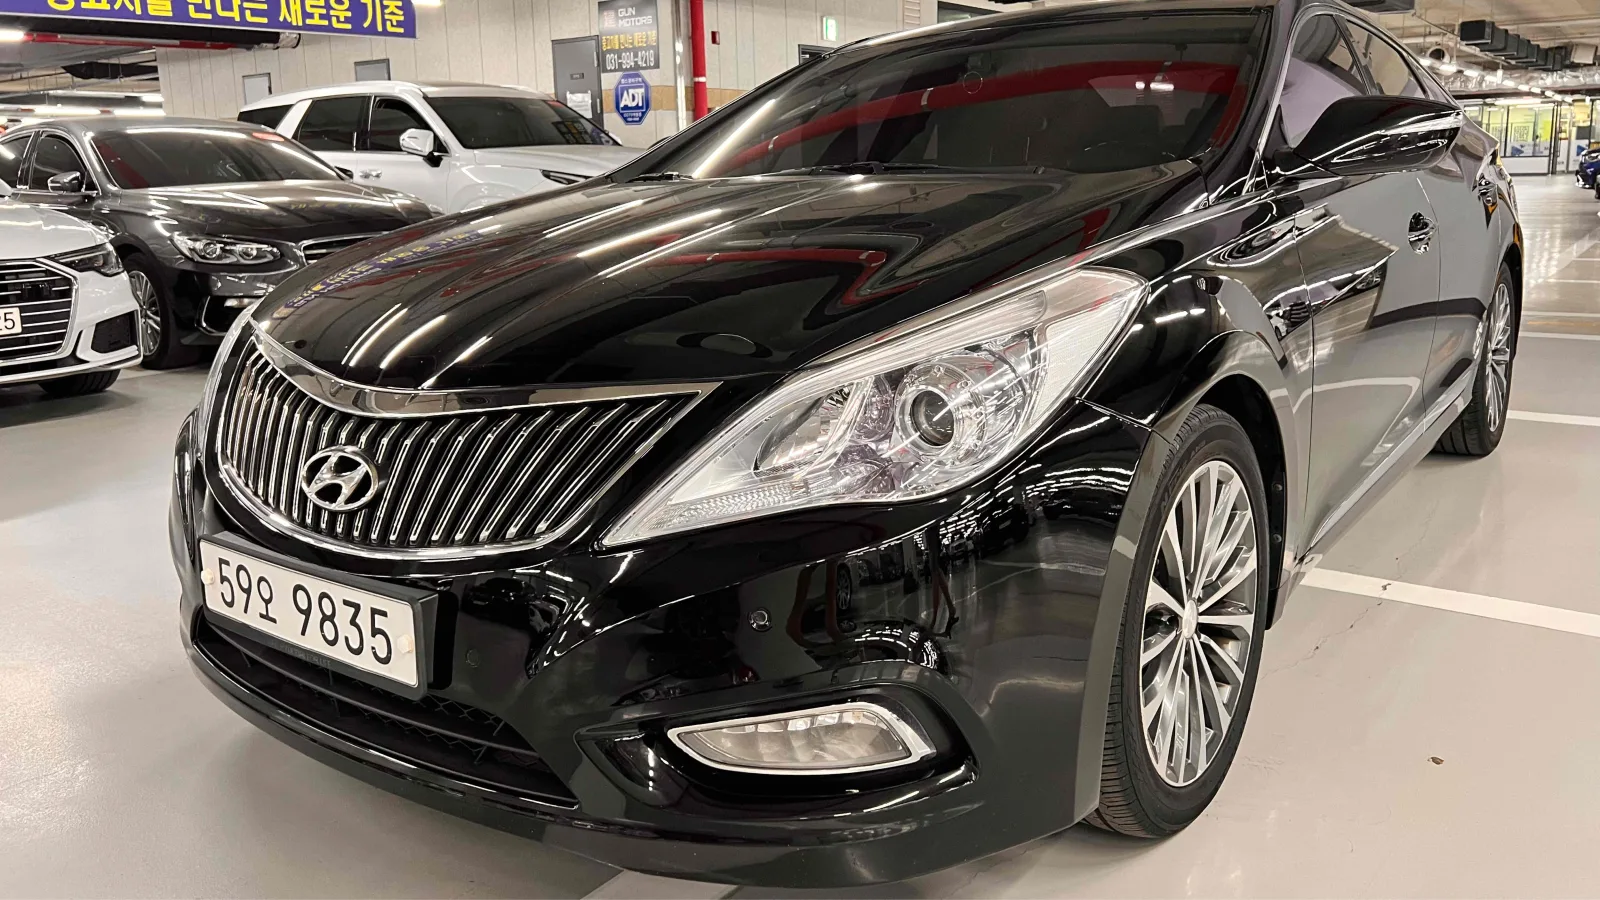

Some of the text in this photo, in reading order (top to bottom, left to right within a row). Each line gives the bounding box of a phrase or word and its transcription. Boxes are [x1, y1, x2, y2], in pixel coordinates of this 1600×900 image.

[279, 0, 352, 29] 새로운
[363, 0, 405, 33] 기준
[617, 7, 636, 17] GUN
[617, 16, 653, 27] MOTORS
[606, 50, 655, 70] 031-994-4219
[620, 88, 644, 107] ADT
[0, 312, 15, 330] 5
[218, 557, 391, 665] 59오 9835
